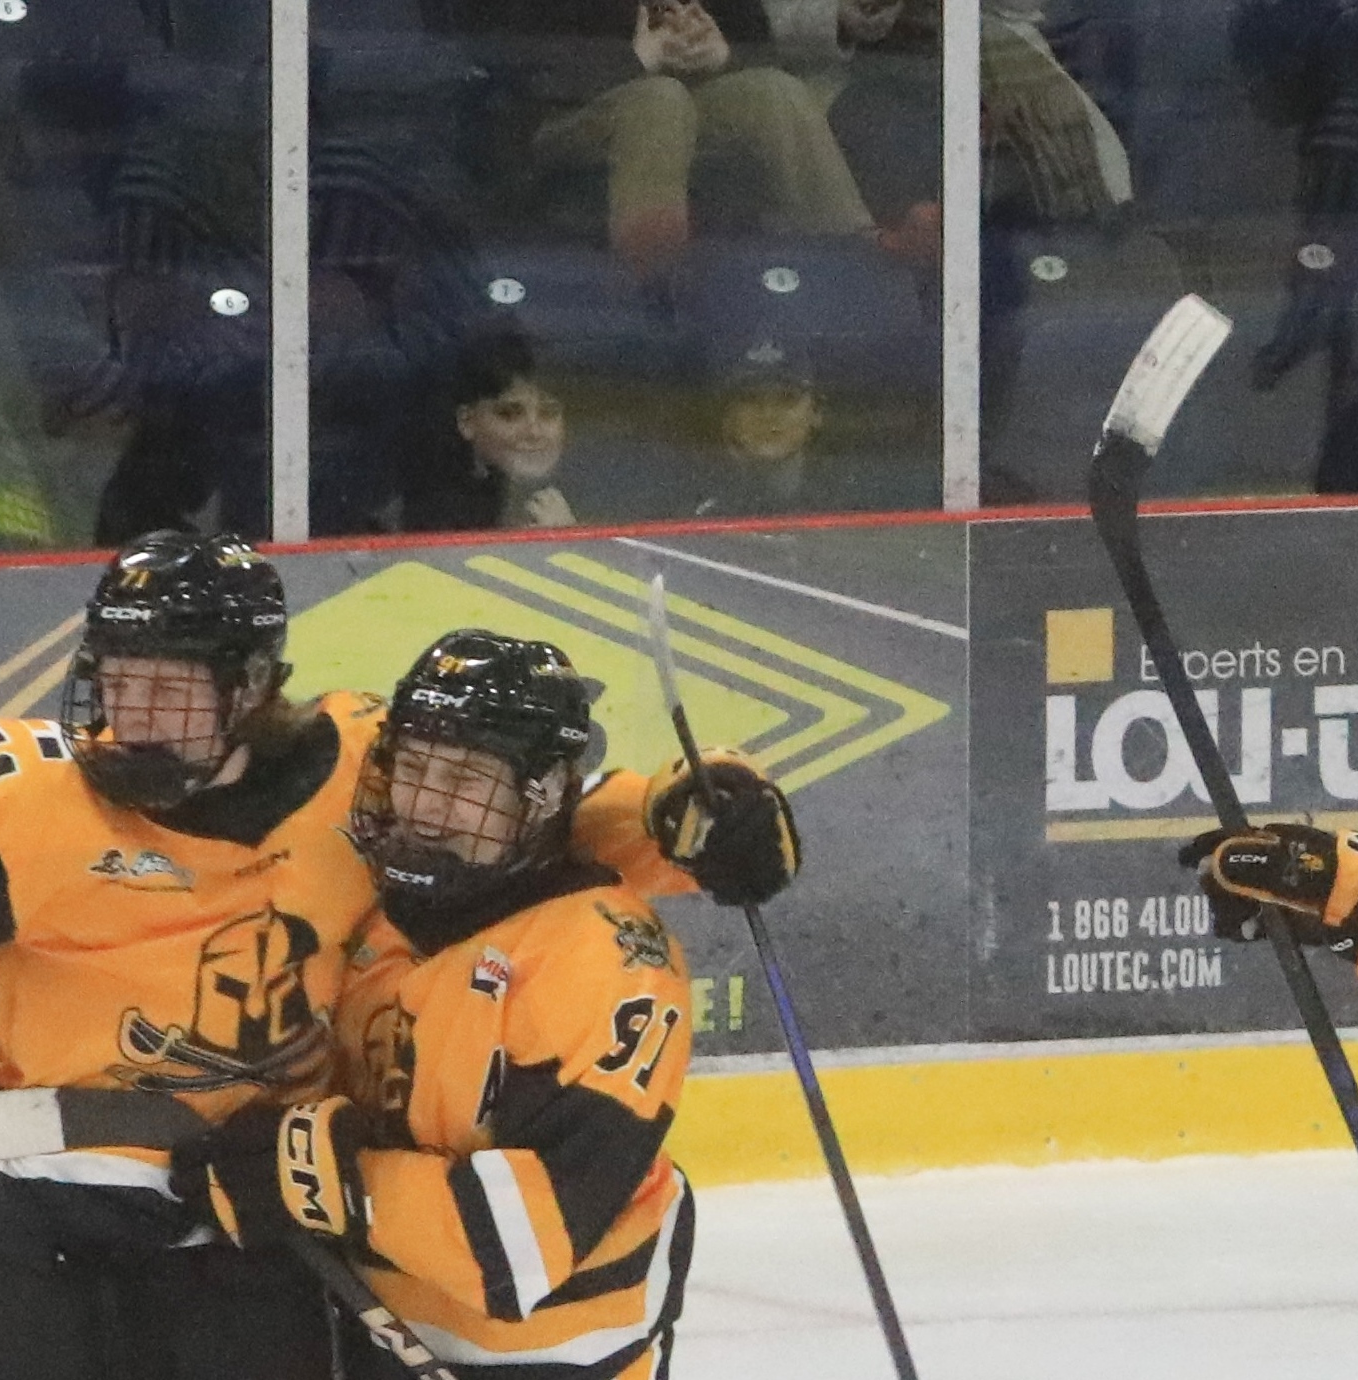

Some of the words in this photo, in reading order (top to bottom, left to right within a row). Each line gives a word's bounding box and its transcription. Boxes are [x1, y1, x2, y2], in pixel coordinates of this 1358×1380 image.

[101, 606, 151, 621] CCM
[253, 613, 284, 627] CCM
[1140, 641, 1281, 681] Eperts
[1293, 644, 1346, 677] en
[411, 687, 472, 708] CCM
[559, 726, 589, 743] CCM
[1229, 854, 1269, 865] CCM
[384, 866, 434, 886] CCM
[1047, 902, 1064, 942] 1
[1074, 898, 1130, 941] 866
[1047, 947, 1223, 995] LOUTEC.COM
[594, 995, 682, 1094] 91
